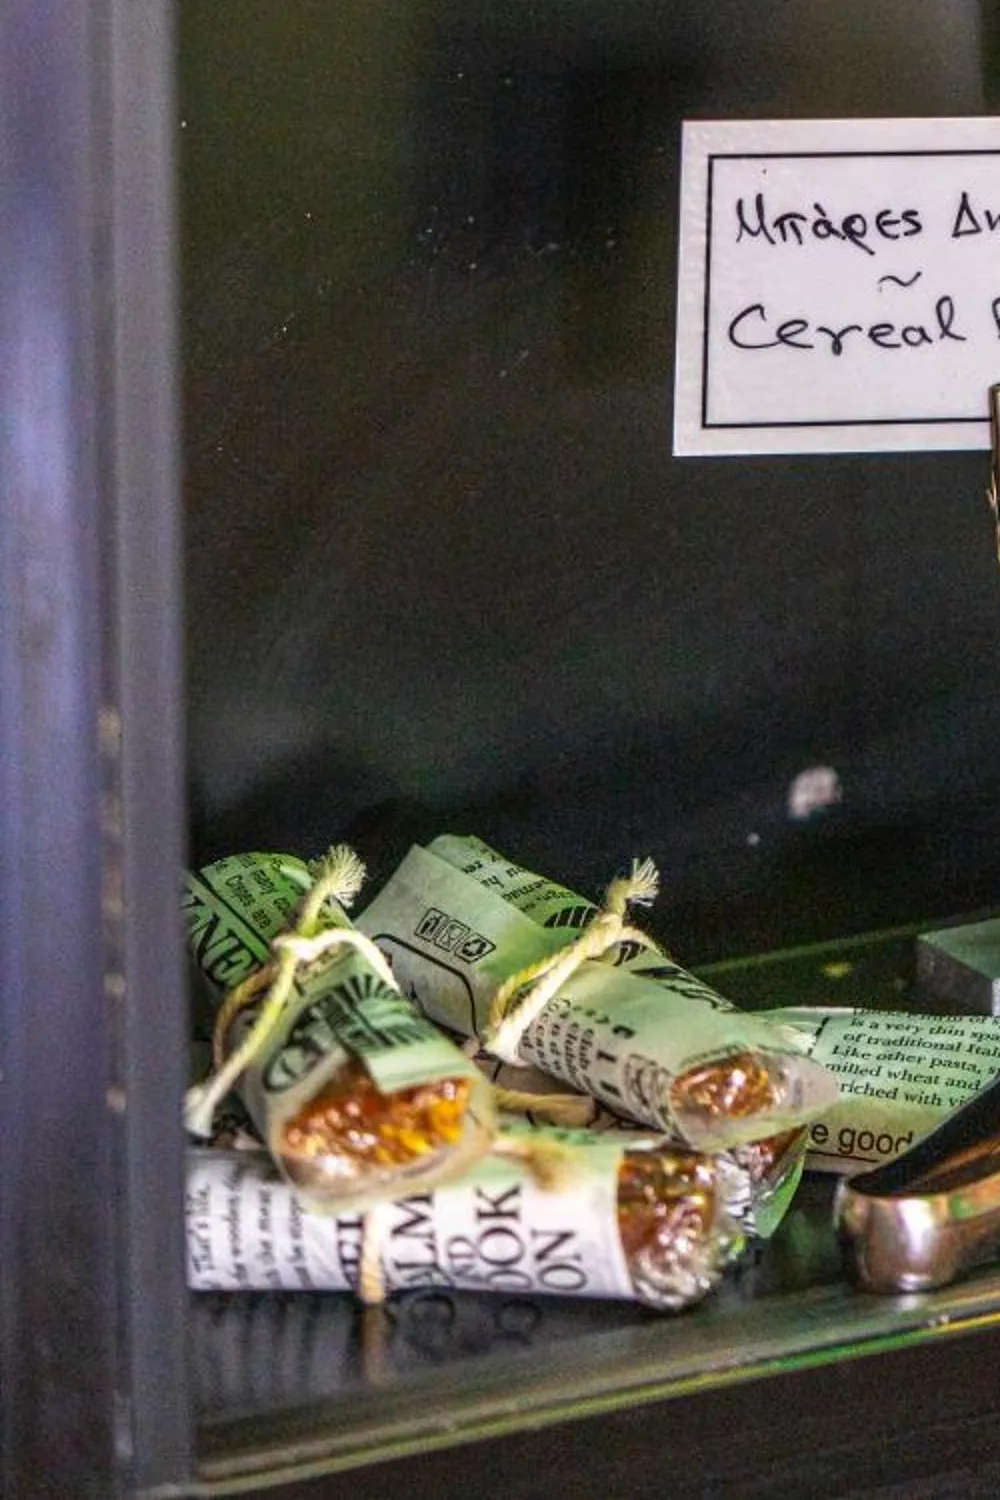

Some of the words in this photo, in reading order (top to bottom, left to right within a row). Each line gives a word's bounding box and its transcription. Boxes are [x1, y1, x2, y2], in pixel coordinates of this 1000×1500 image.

[728, 295, 967, 356] Cereal
[843, 1032, 866, 1044] of
[867, 1035, 963, 1054] traditional
[869, 1021, 880, 1031] a
[886, 1022, 923, 1035] very
[929, 1025, 966, 1038] thin
[832, 1045, 873, 1062] Like
[876, 1050, 927, 1065] other
[929, 1056, 982, 1076] pasta,
[824, 1061, 883, 1079] milled
[887, 1070, 940, 1088] wheat
[945, 1076, 982, 1093] and
[839, 1081, 899, 1102] riched
[903, 1091, 943, 1108] with
